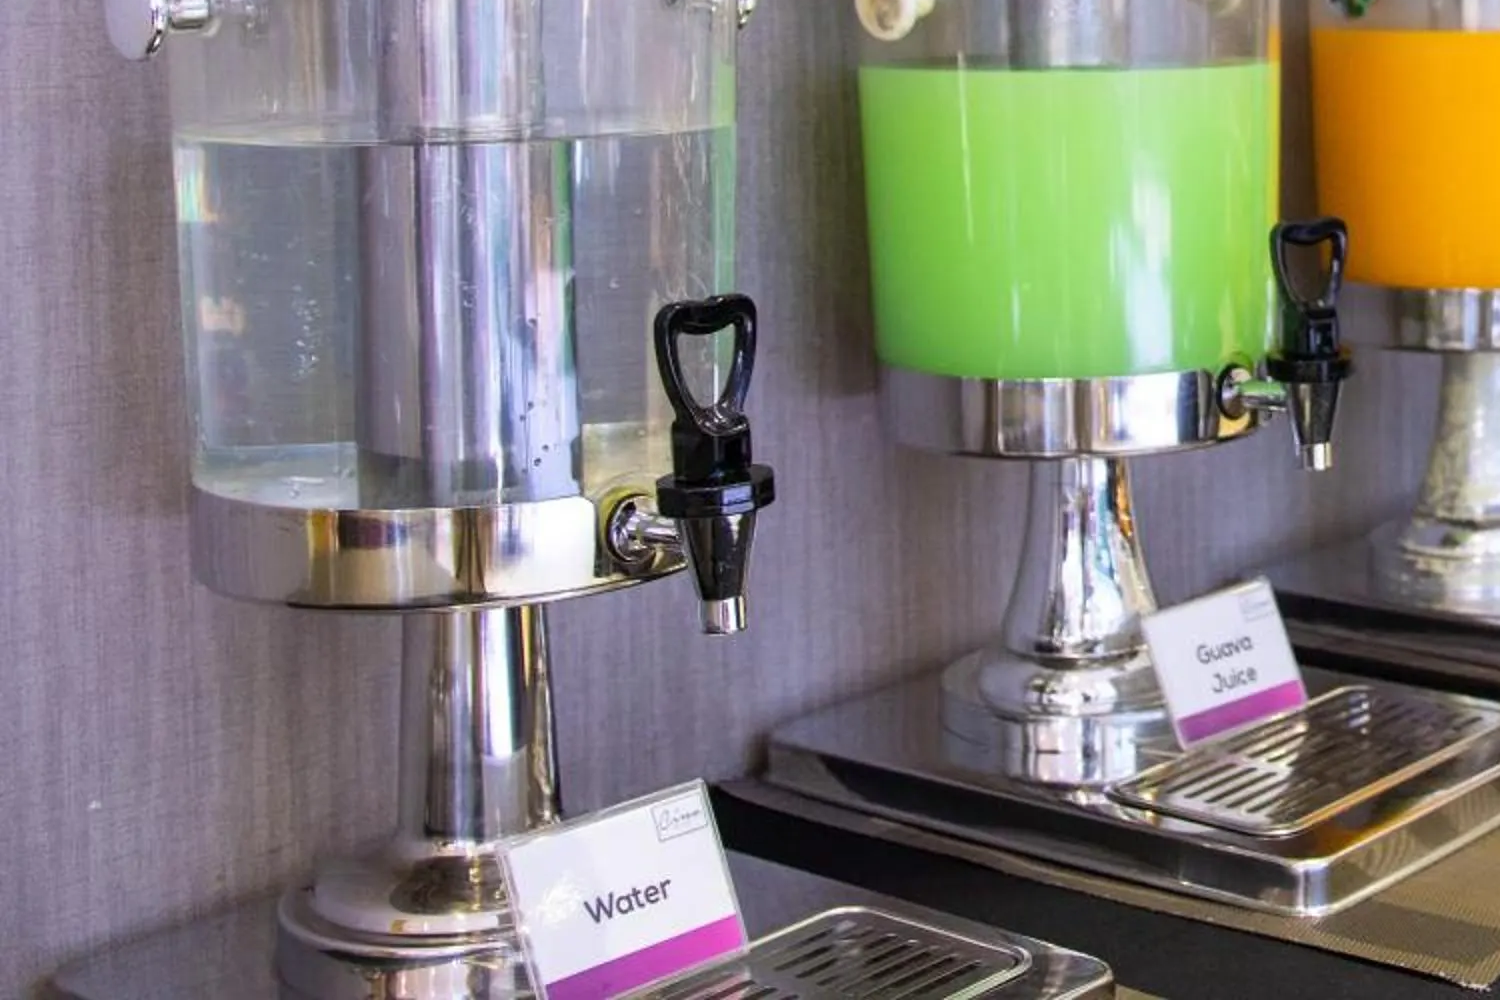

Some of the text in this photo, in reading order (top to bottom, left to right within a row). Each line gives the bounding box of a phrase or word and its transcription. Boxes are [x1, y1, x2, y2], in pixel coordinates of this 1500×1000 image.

[1196, 636, 1254, 665] Guava
[1211, 666, 1258, 693] Juice
[583, 878, 672, 924] Water
